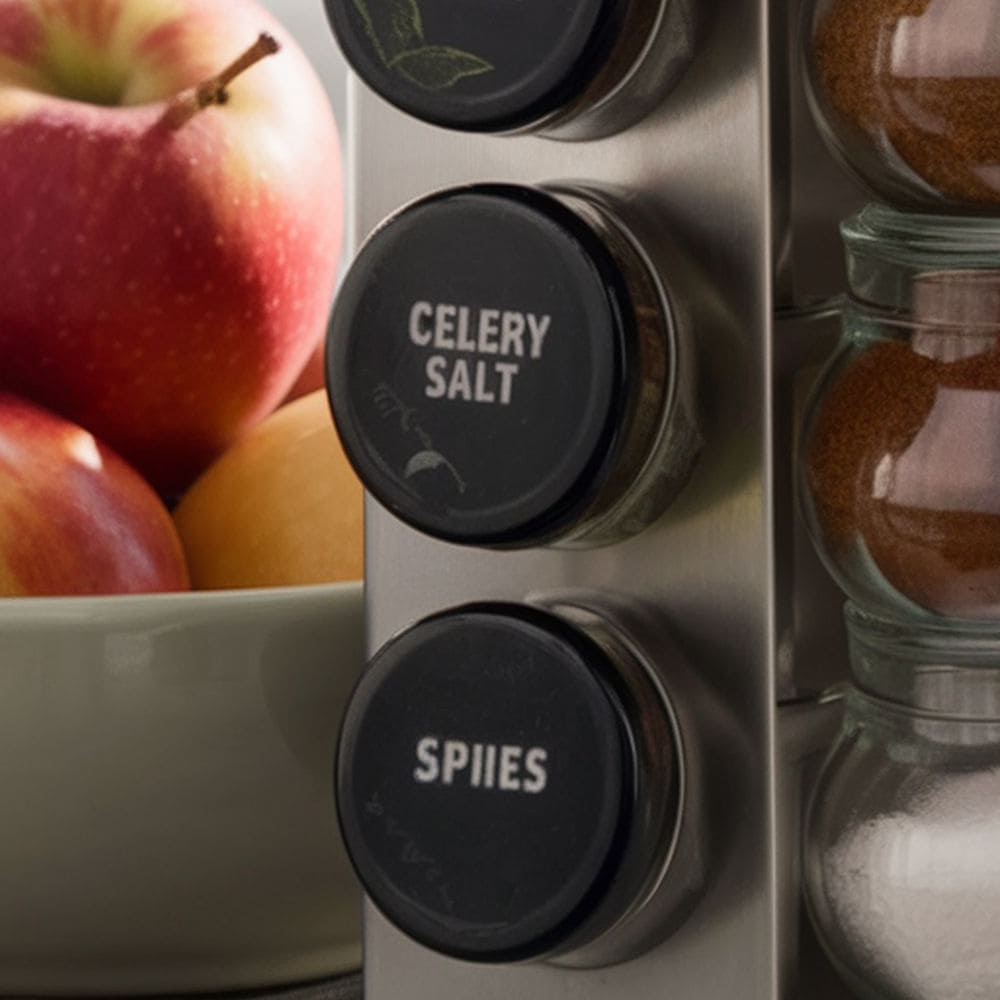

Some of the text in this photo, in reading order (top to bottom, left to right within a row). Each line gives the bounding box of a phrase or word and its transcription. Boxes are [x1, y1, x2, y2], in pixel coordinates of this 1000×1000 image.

[408, 302, 551, 360] CELERY
[425, 354, 518, 405] SALT
[414, 737, 548, 794] SPIIES
